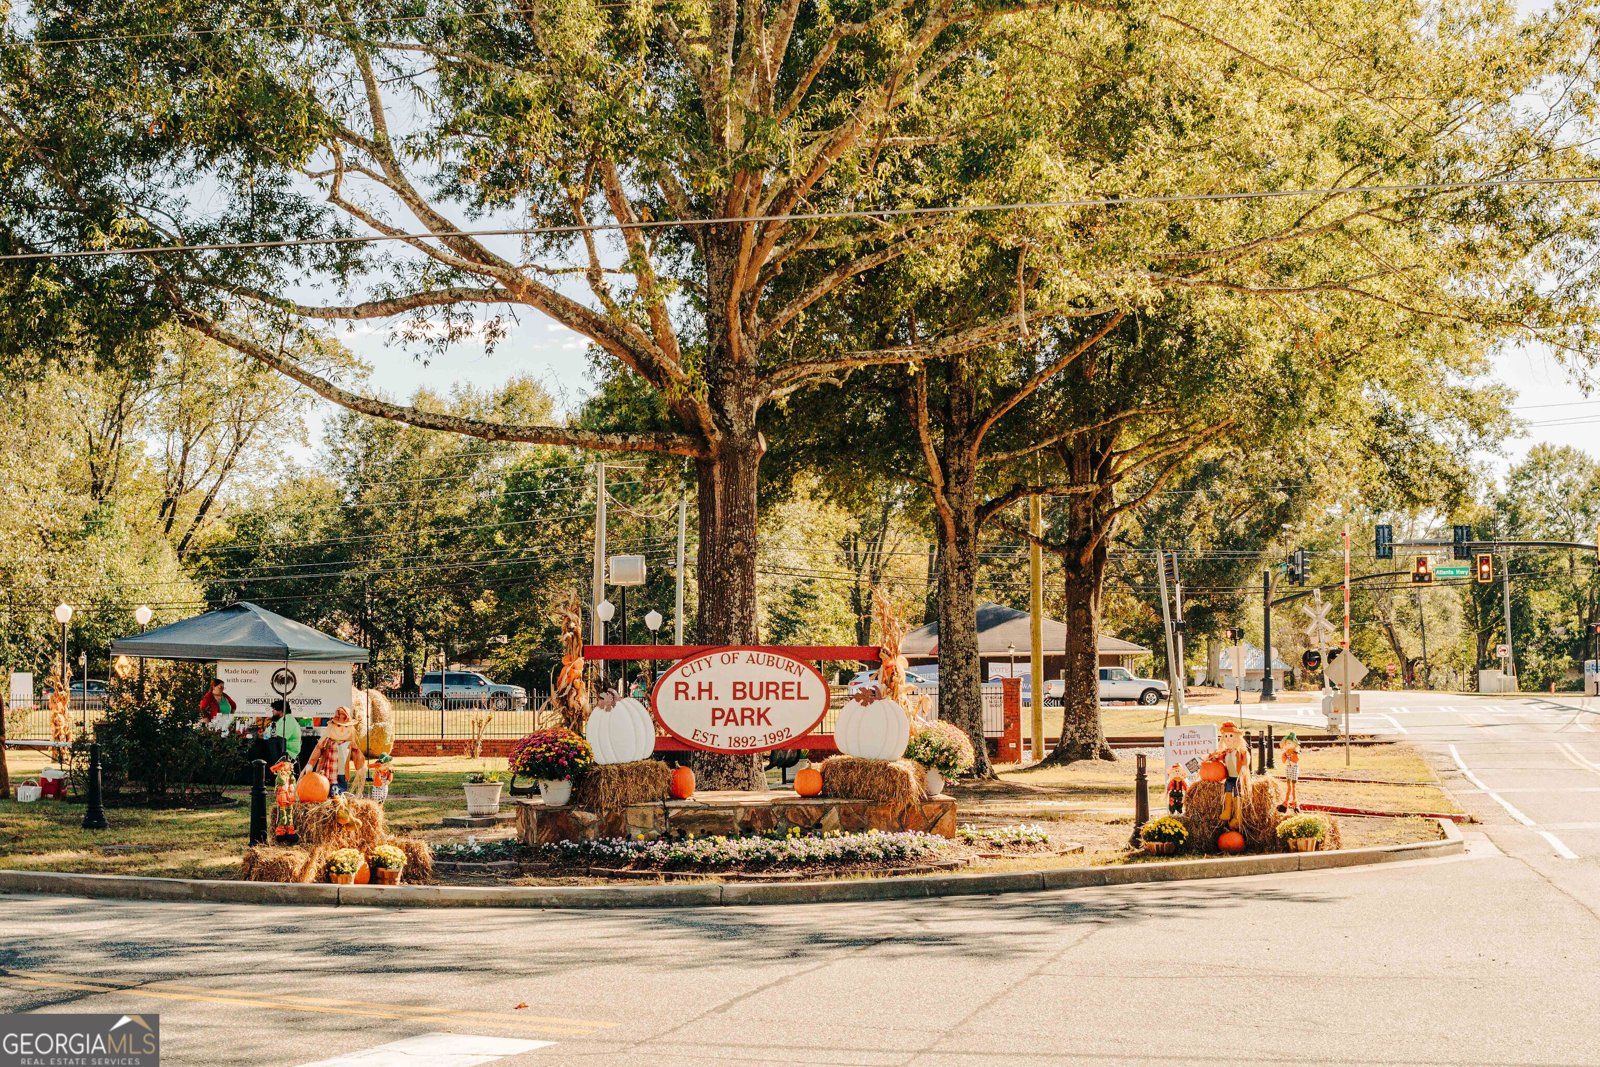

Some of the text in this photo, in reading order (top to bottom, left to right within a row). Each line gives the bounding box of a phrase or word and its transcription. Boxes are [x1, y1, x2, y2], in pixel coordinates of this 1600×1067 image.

[240, 668, 259, 676] locally
[681, 652, 805, 678] CITY OF AUBURN
[674, 681, 809, 701] R.H. BUREL
[711, 707, 772, 727] PARK
[691, 727, 793, 747] EST. 1892-1992
